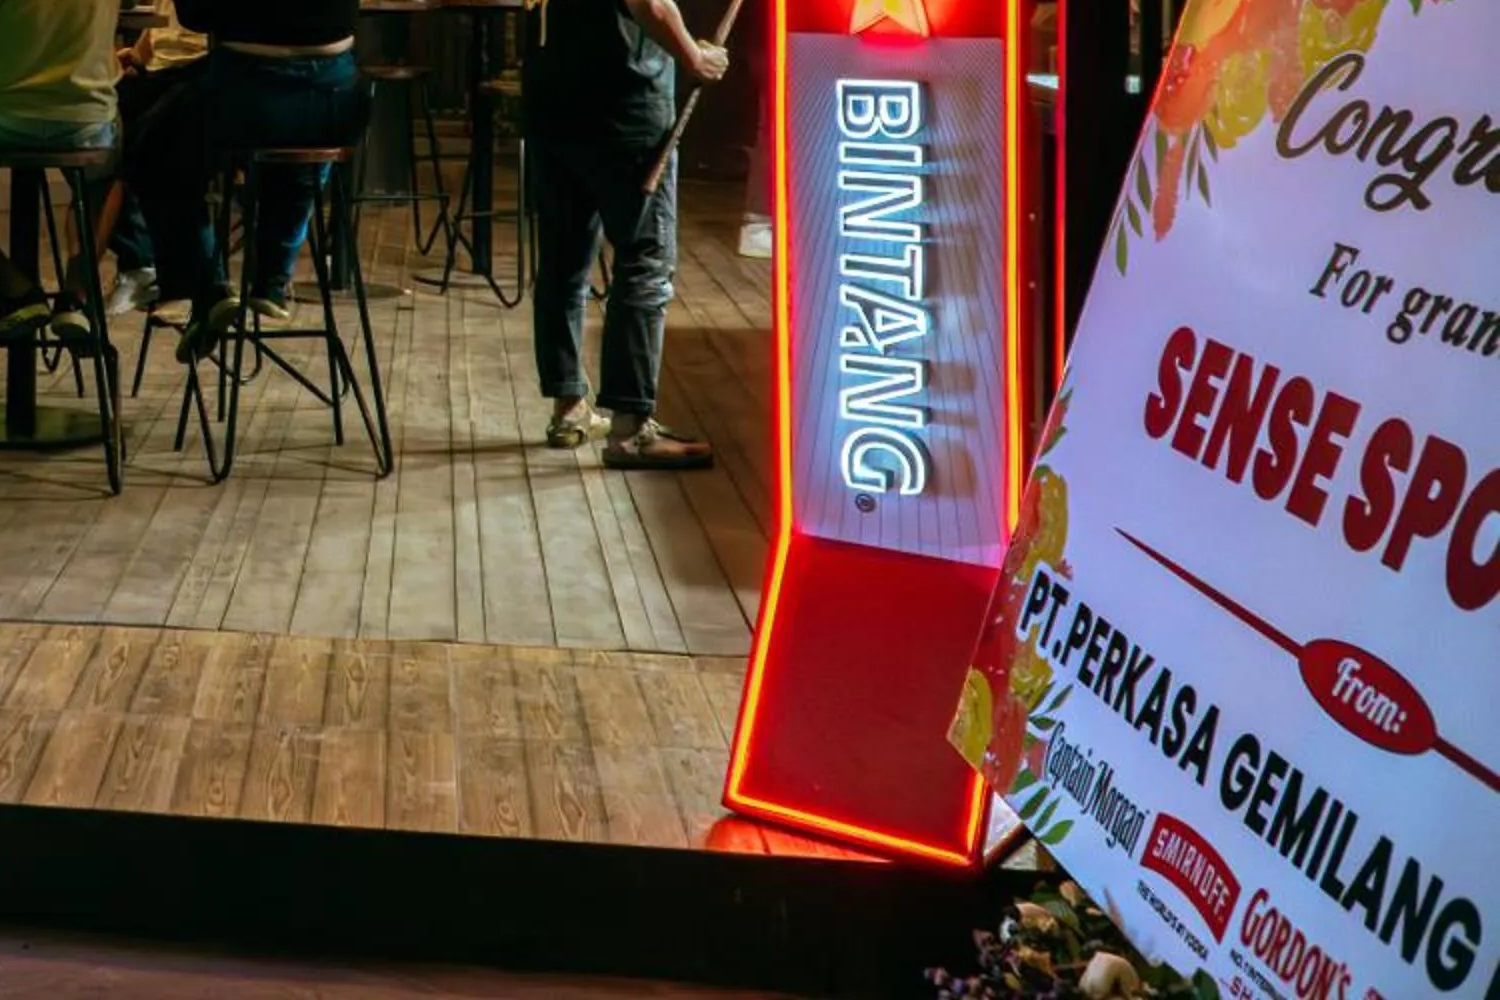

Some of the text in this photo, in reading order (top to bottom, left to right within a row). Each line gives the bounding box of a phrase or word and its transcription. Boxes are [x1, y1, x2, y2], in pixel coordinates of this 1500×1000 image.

[836, 79, 928, 496] BINTANG
[1309, 242, 1394, 314] For
[1144, 326, 1362, 528] SENSE
[1332, 657, 1407, 734] From:
[1152, 827, 1231, 916] SMIRNOFF
[1219, 733, 1482, 992] GEMILANG
